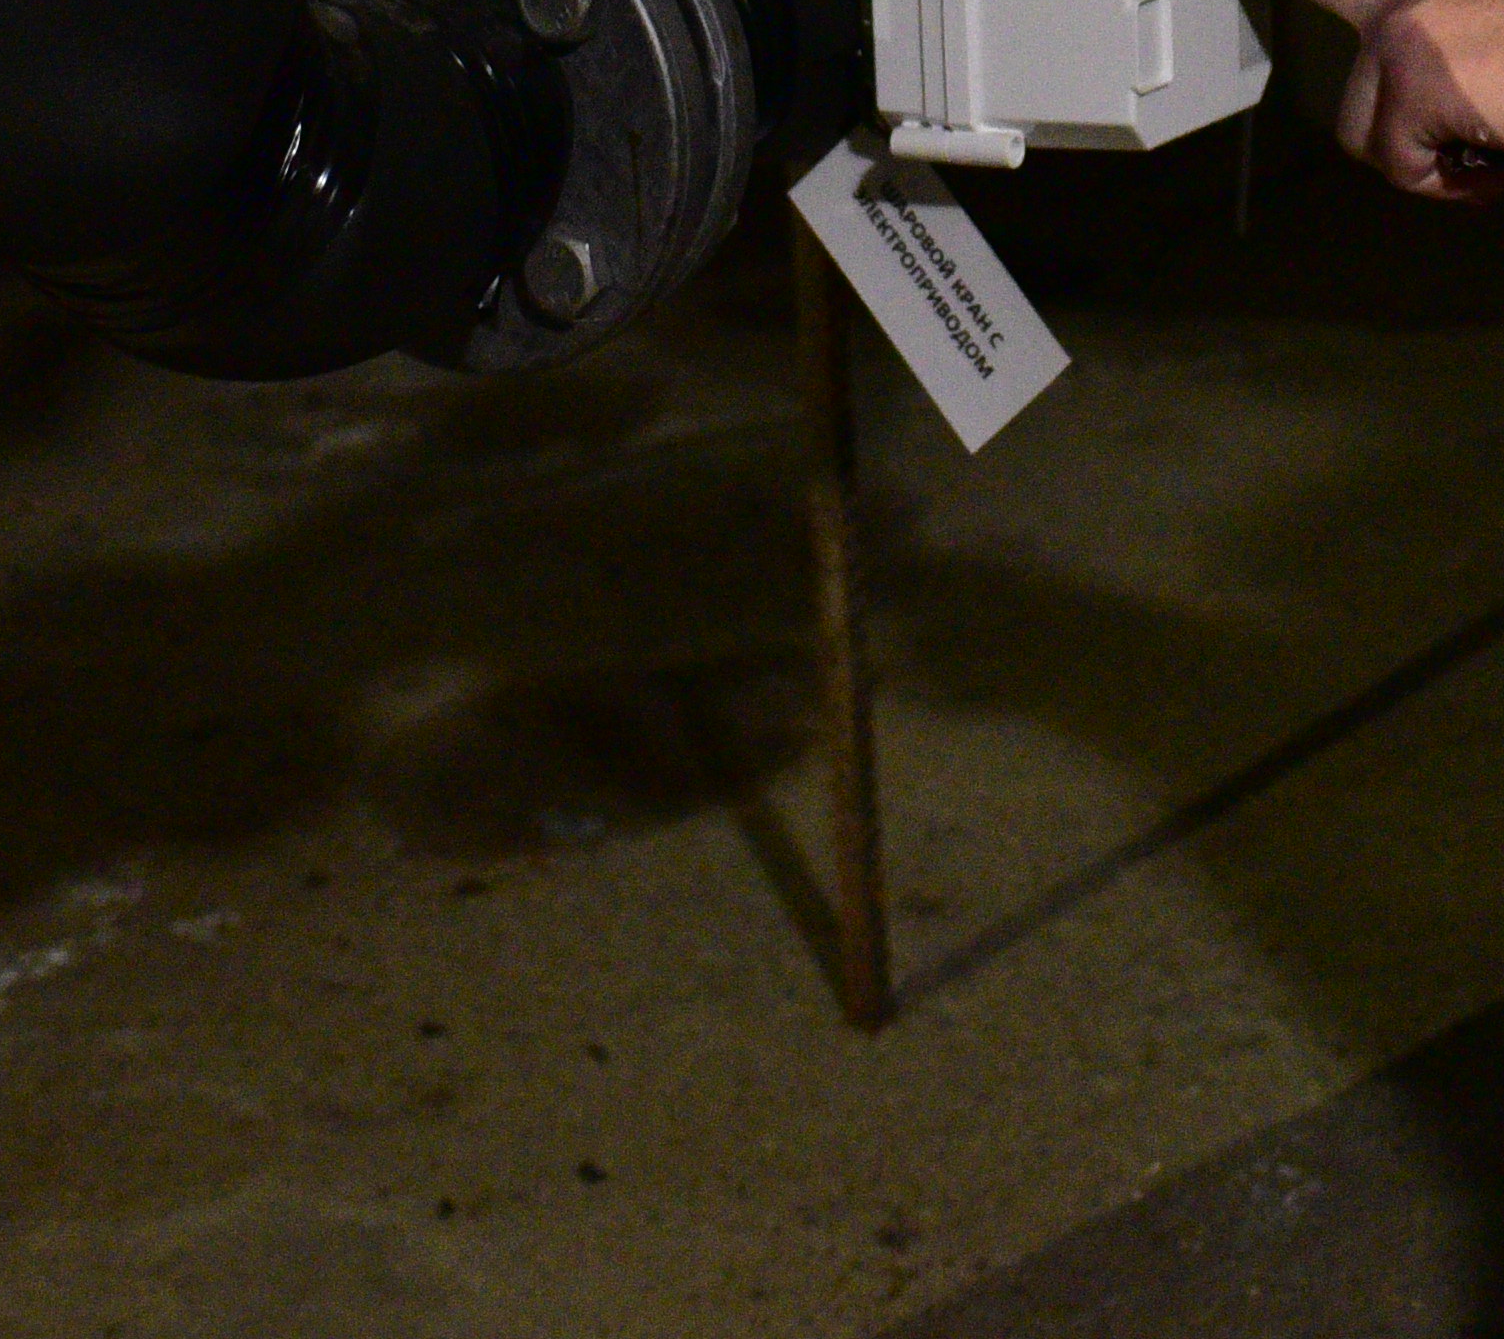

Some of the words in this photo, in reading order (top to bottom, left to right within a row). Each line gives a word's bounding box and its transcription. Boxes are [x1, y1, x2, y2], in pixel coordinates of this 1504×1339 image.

[854, 190, 995, 379] ЭЛЕКТРОПРИВОДОМ
[882, 183, 956, 280] ШАРОВОЙ
[951, 277, 992, 331] КРАН
[989, 332, 1004, 349] С
